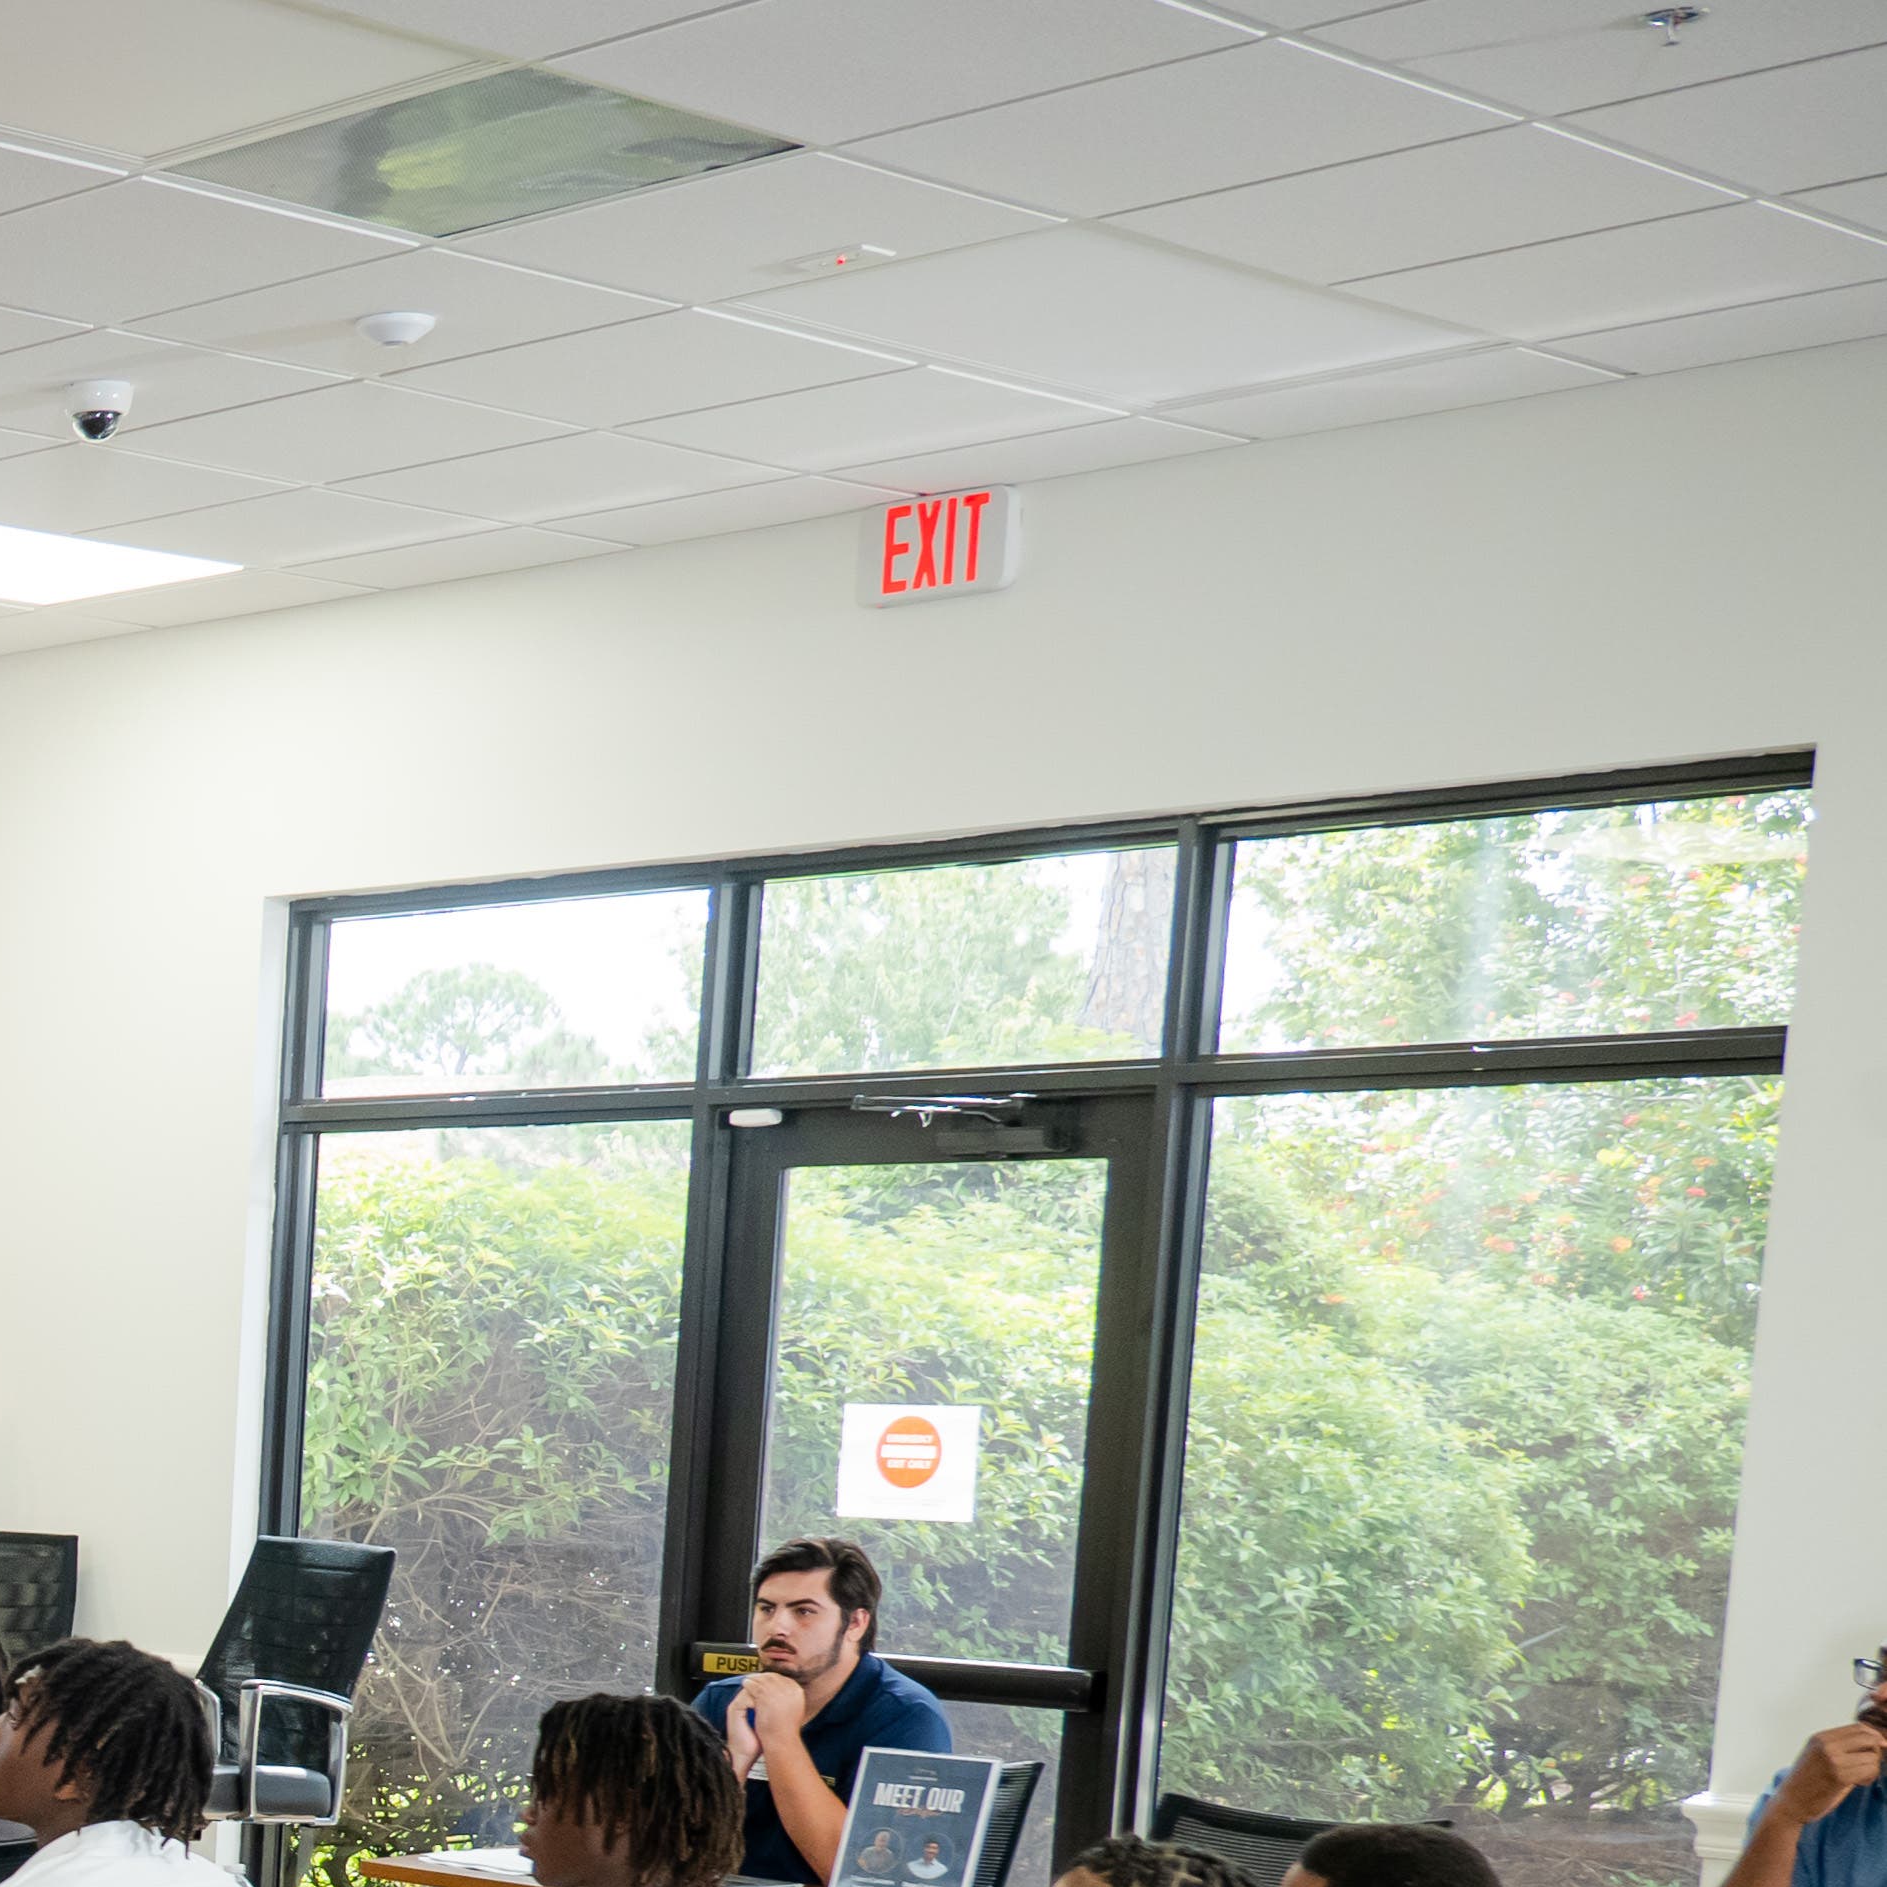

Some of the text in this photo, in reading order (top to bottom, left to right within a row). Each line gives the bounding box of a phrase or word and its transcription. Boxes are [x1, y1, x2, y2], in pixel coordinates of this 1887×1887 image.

[881, 492, 992, 595] EXIT
[717, 1657, 759, 1672] PUSH
[873, 1782, 926, 1811] MEET
[926, 1786, 965, 1813] OUR
